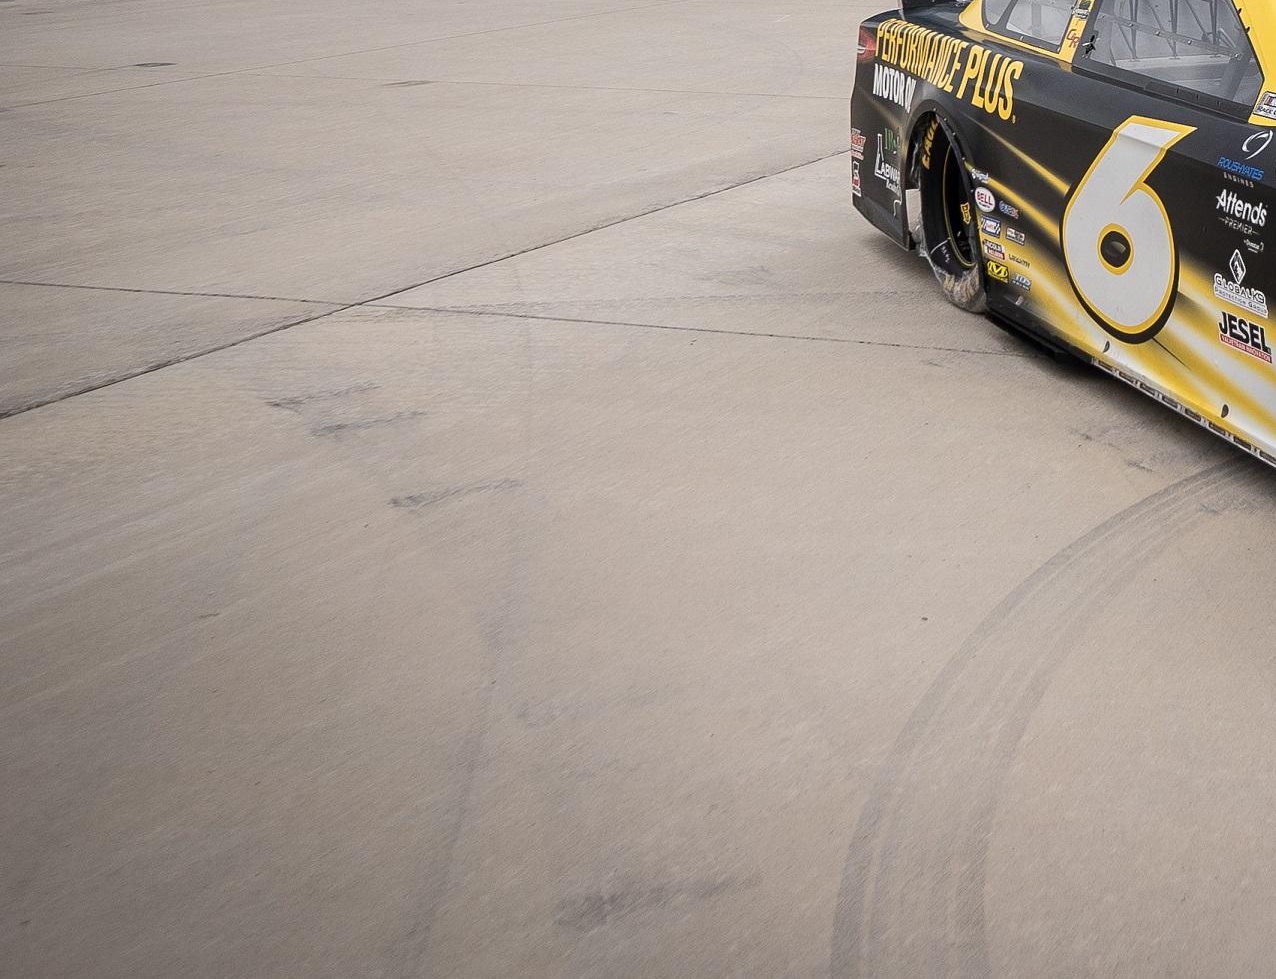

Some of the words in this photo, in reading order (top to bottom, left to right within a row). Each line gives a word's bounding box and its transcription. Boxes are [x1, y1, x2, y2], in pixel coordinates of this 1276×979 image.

[873, 63, 905, 108] MOTOR
[875, 18, 969, 93] PERFORMANCE
[956, 45, 1024, 121] PLUS
[1223, 171, 1255, 189] ENGINES
[1062, 115, 1198, 338] 6
[1216, 188, 1267, 227] Attends
[1218, 311, 1271, 355] JESEL
